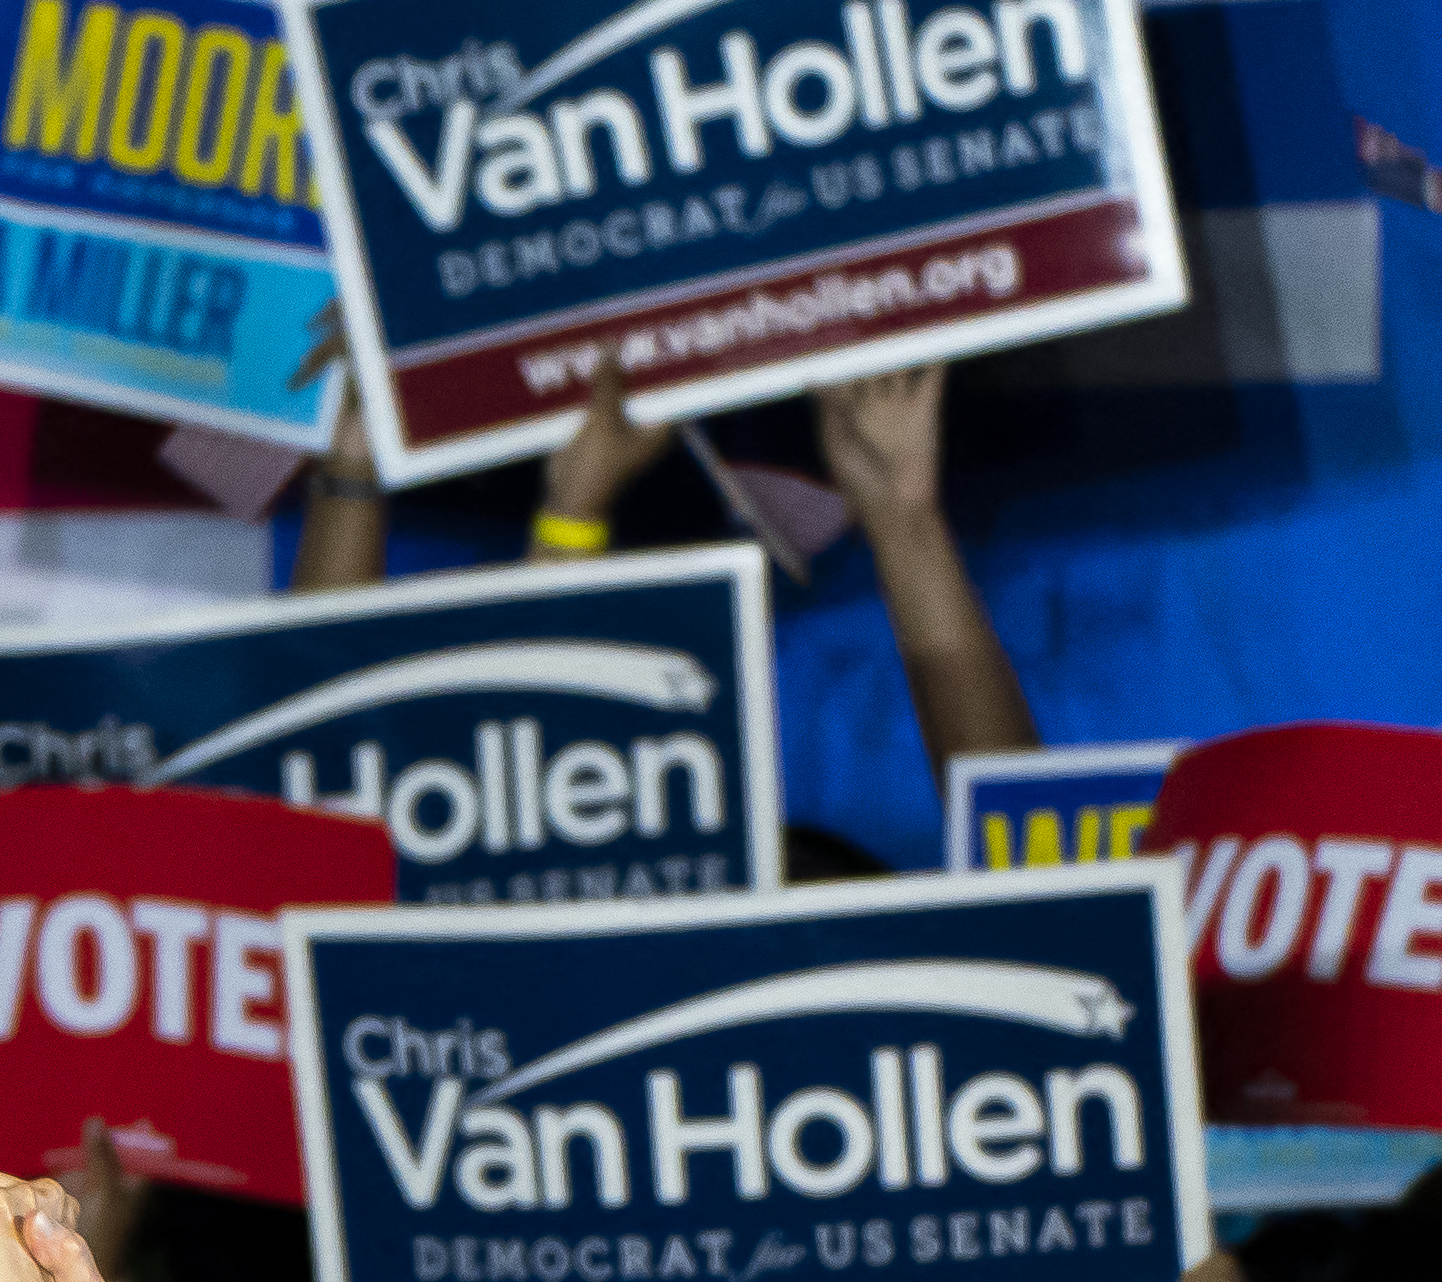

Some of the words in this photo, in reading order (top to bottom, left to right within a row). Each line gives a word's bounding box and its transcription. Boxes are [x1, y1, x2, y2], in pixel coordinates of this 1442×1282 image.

[3, 0, 324, 208] MOOR
[349, 37, 524, 121] Chris
[364, 86, 654, 234] Van
[648, 0, 1087, 175] Hollen
[436, 182, 748, 299] DEMOCRAT
[809, 150, 885, 210] US
[888, 100, 1104, 194] SENATE
[24, 219, 248, 360] MILLER
[281, 716, 724, 866] Hollen
[1174, 832, 1442, 993] VOTE
[342, 1013, 514, 1078] Chris
[350, 1072, 632, 1212] Van
[645, 1042, 1145, 1204] Hollen
[410, 1226, 734, 1282] DEMOCRAT
[813, 1218, 897, 1270] US
[909, 1197, 1154, 1265] SENATE
